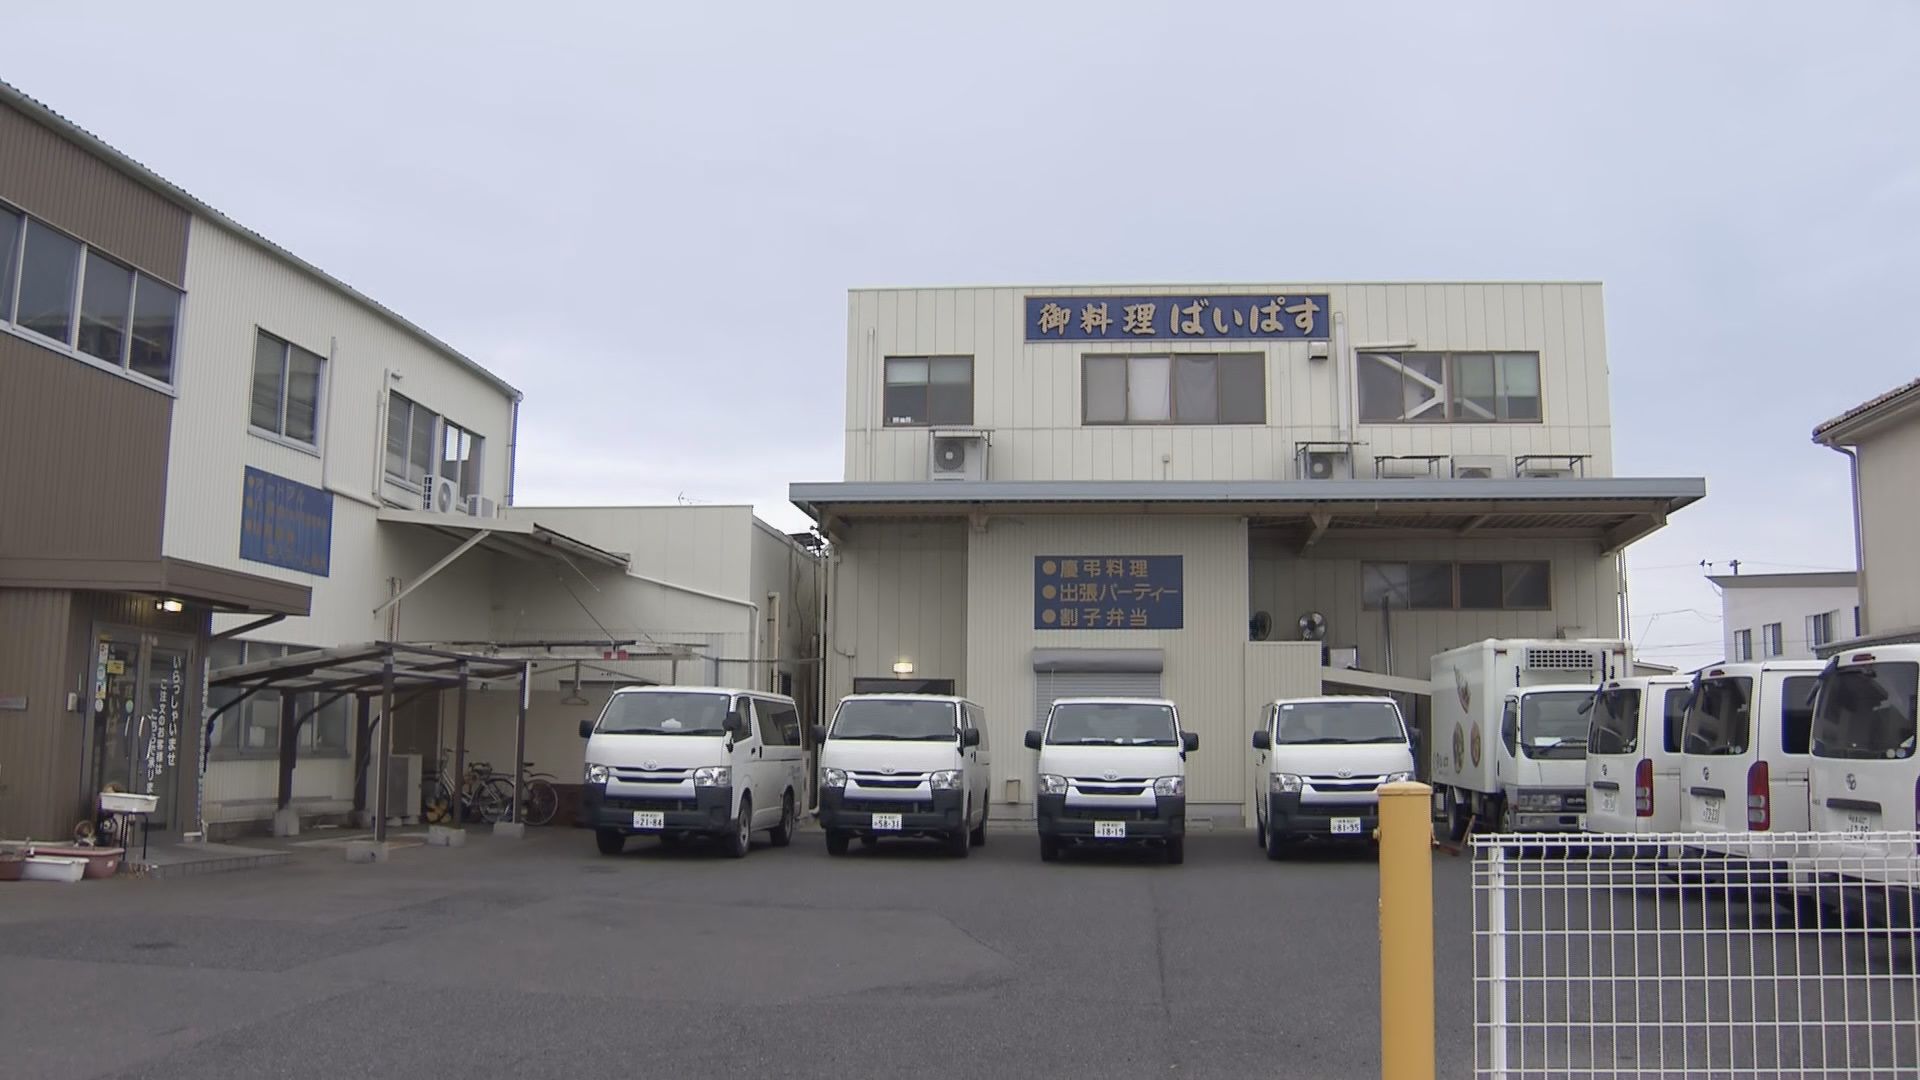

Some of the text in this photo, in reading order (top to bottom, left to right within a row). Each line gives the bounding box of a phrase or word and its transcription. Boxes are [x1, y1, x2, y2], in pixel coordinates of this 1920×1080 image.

[1060, 559, 1149, 578] 慶弔料理
[1060, 584, 1177, 603] 出張パーティー
[1060, 608, 1148, 628] 割子弁当
[168, 655, 182, 766] いらっしゃいませ
